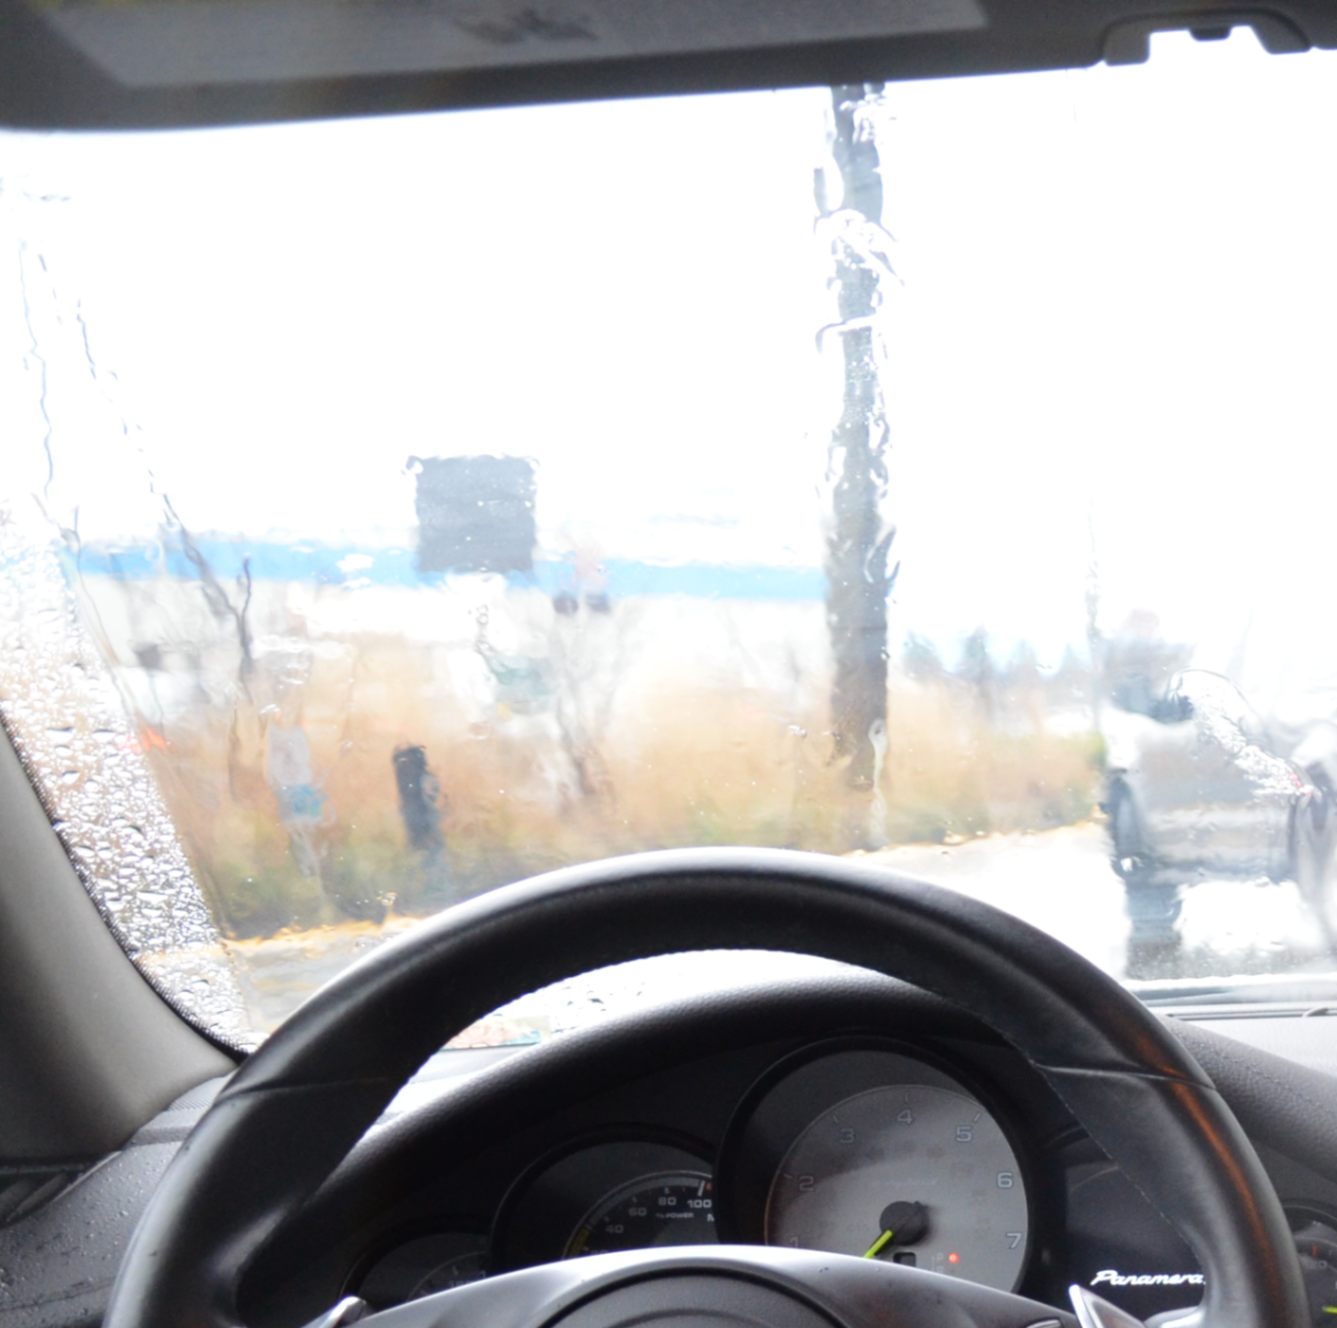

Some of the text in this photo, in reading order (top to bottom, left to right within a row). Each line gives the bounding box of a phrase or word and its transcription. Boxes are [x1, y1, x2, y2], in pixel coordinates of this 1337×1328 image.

[897, 1109, 912, 1125] 4
[840, 1128, 855, 1143] 3
[956, 1126, 972, 1142] 5
[799, 1176, 815, 1192] 2
[997, 1172, 1013, 1188] 6
[686, 1198, 712, 1209] 100
[1006, 1232, 1022, 1249] 7
[1090, 1269, 1203, 1286] Panamera
